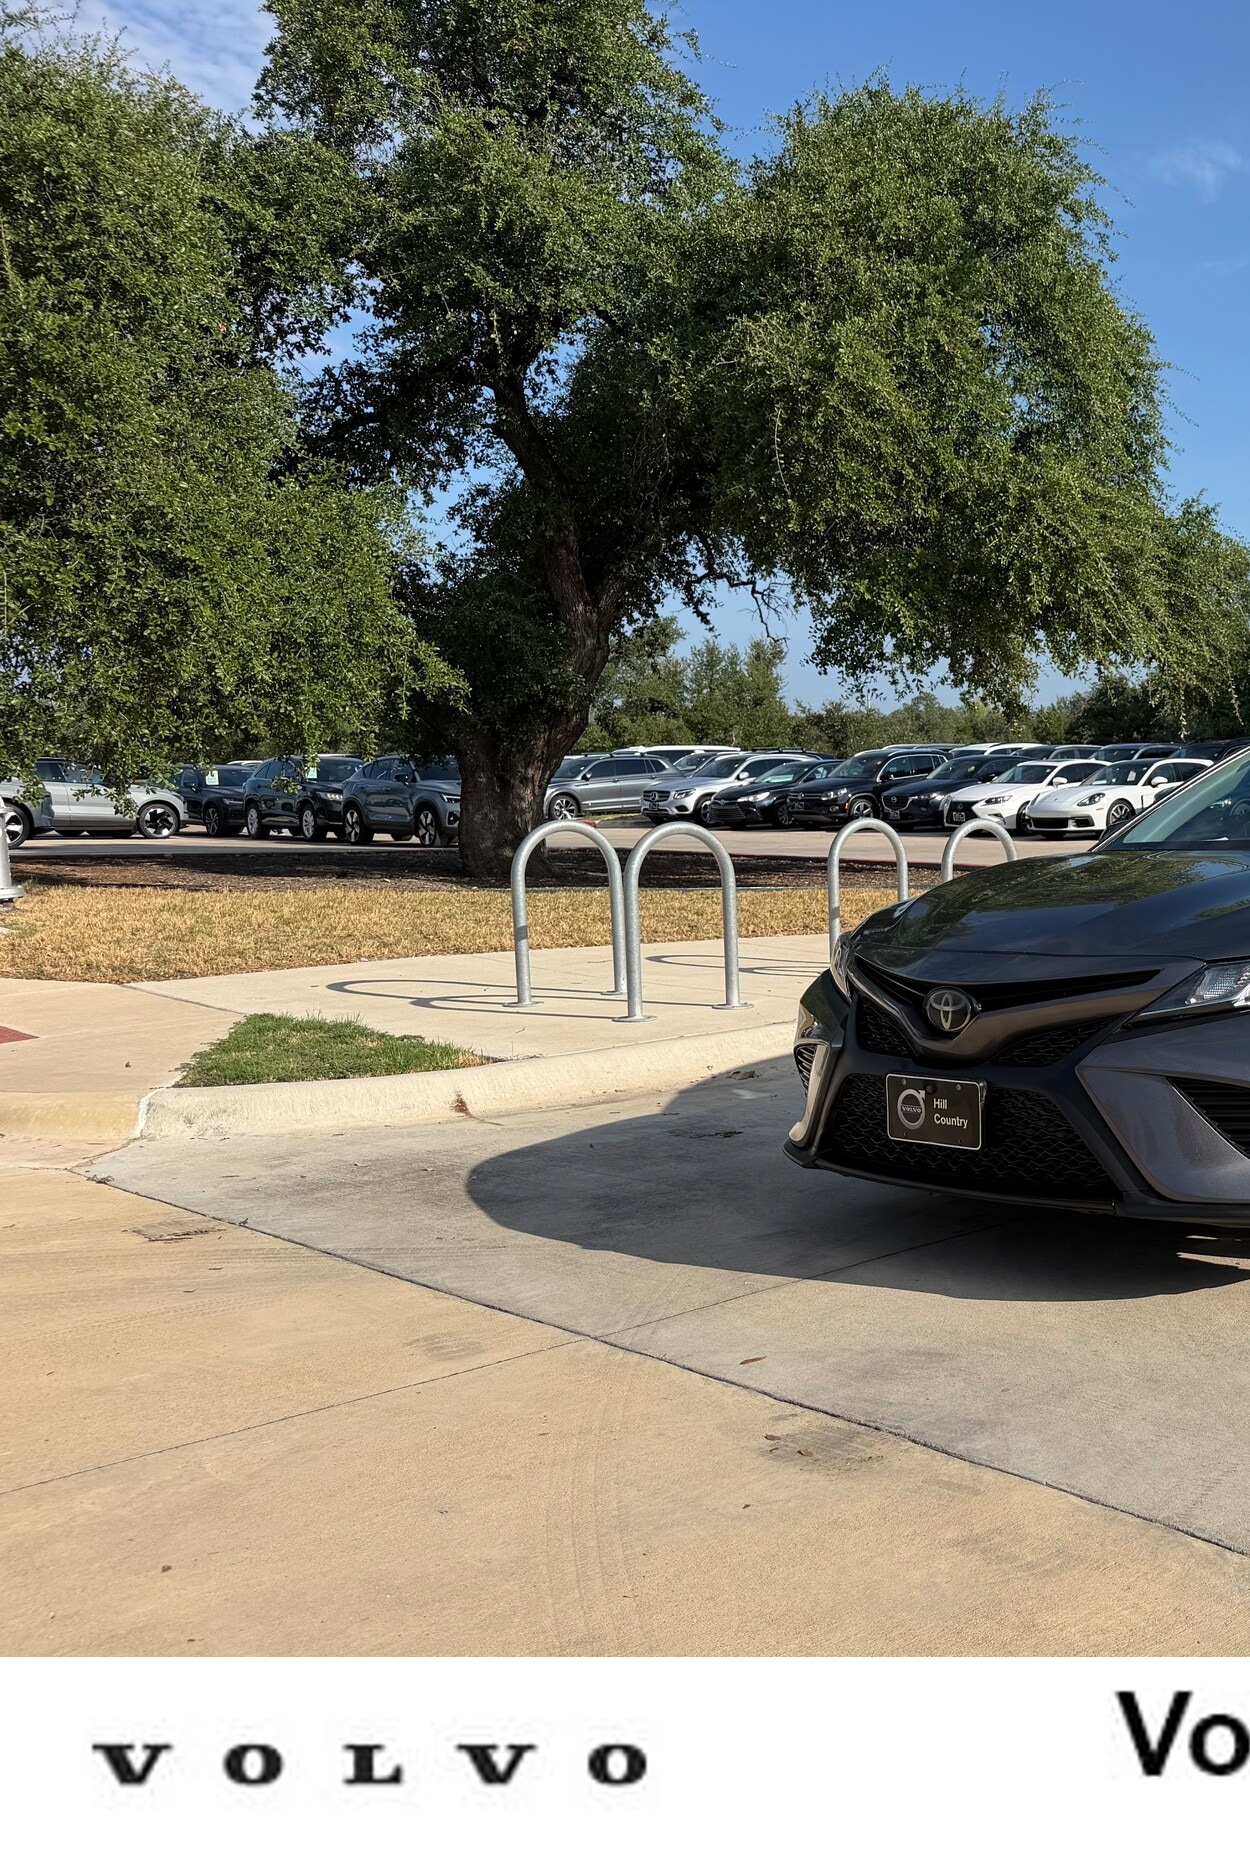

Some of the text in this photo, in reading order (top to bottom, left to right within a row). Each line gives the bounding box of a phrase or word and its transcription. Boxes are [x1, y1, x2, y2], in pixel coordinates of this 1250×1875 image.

[901, 1105, 922, 1113] VOLVO
[933, 1098, 948, 1110] Hill
[933, 1113, 968, 1129] Country
